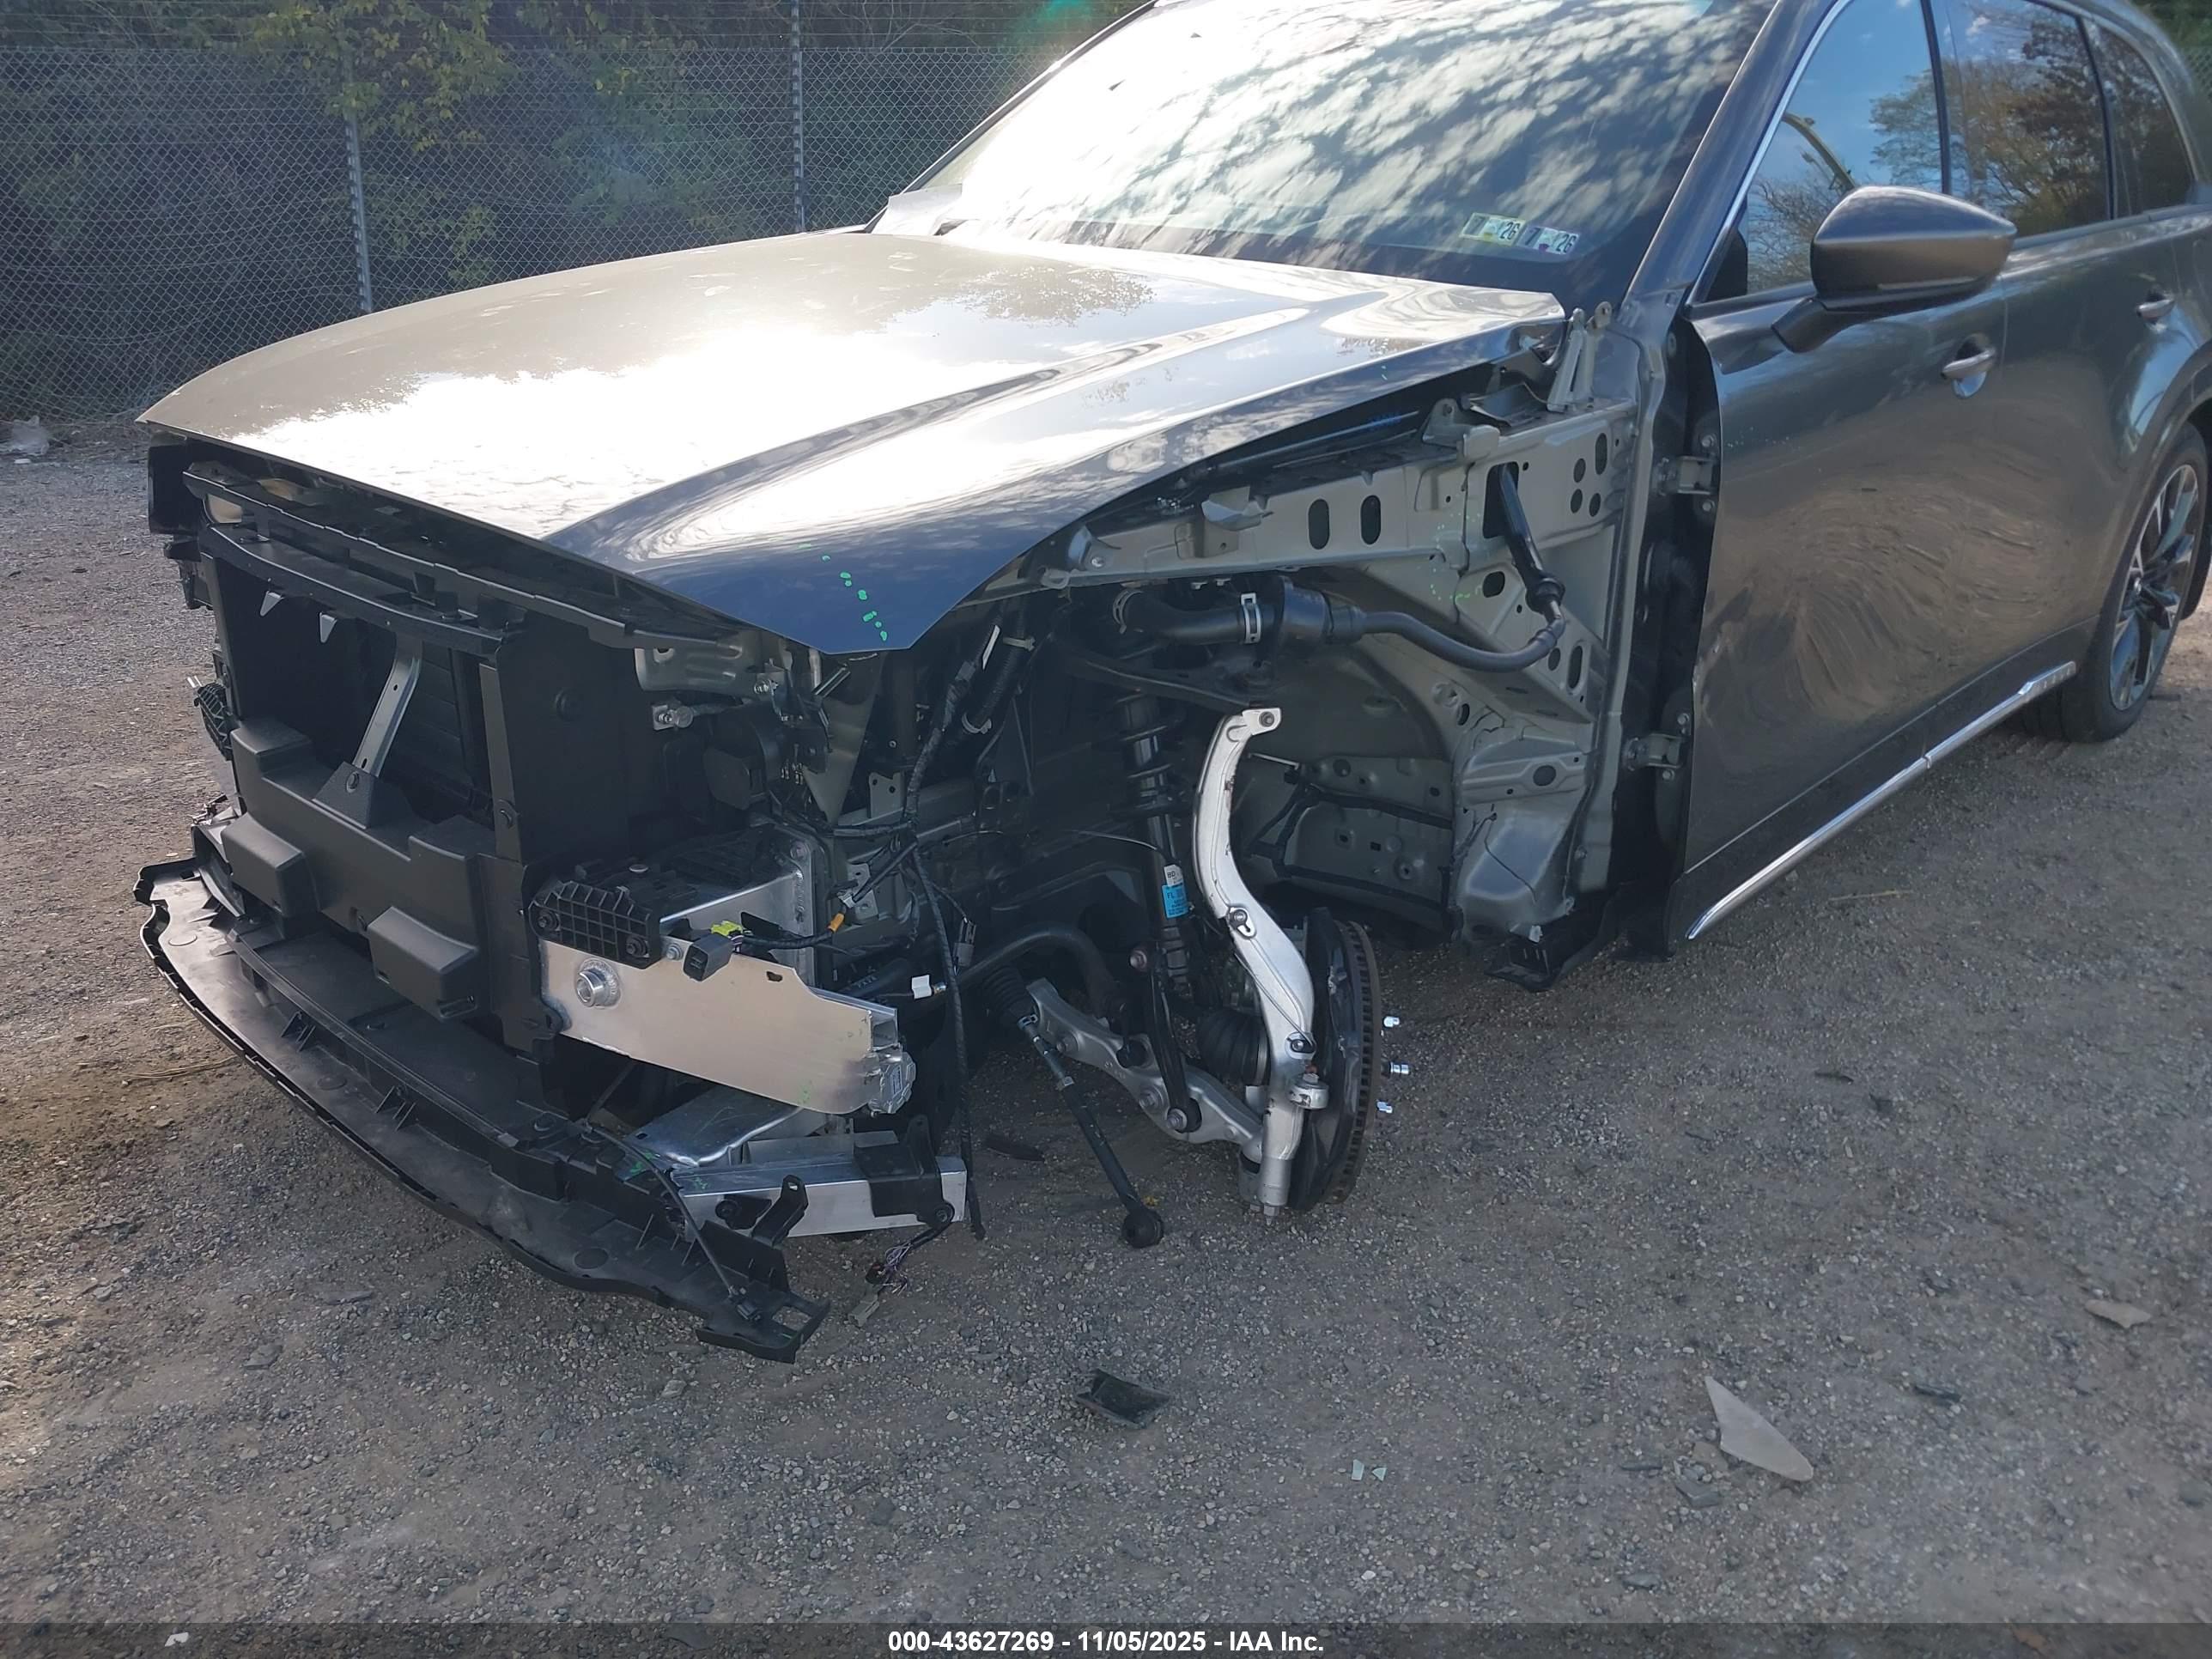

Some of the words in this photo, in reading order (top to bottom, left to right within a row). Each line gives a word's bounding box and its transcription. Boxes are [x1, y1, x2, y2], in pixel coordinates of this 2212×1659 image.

[1500, 222, 1521, 240] 26
[1525, 227, 1541, 246] 7
[1556, 234, 1577, 253] 26
